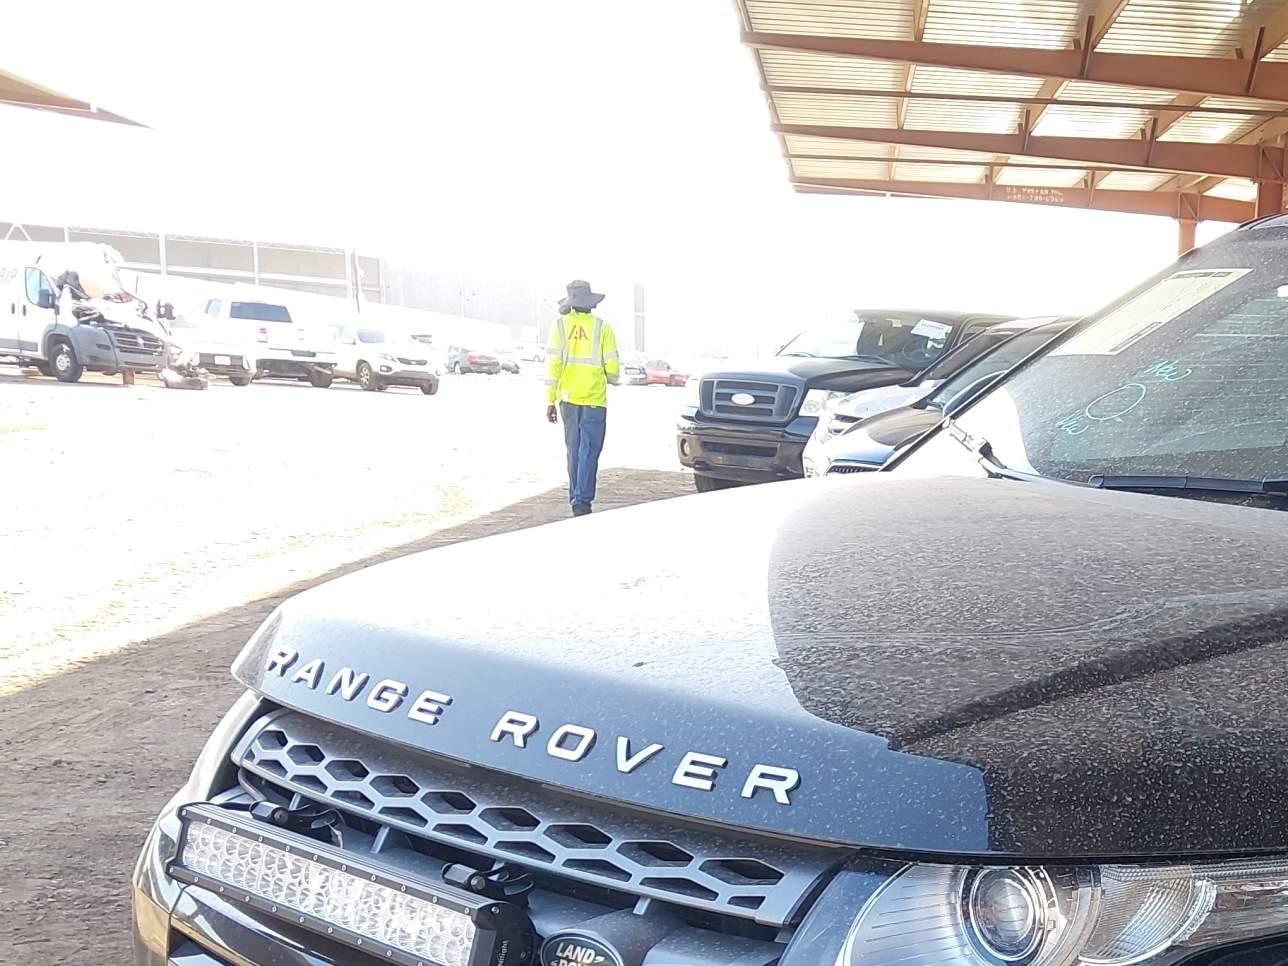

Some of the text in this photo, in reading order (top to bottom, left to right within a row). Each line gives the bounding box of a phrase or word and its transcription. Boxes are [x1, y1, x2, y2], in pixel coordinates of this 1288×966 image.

[265, 648, 801, 806] RANGE ROVER
[556, 942, 595, 964] LAND
